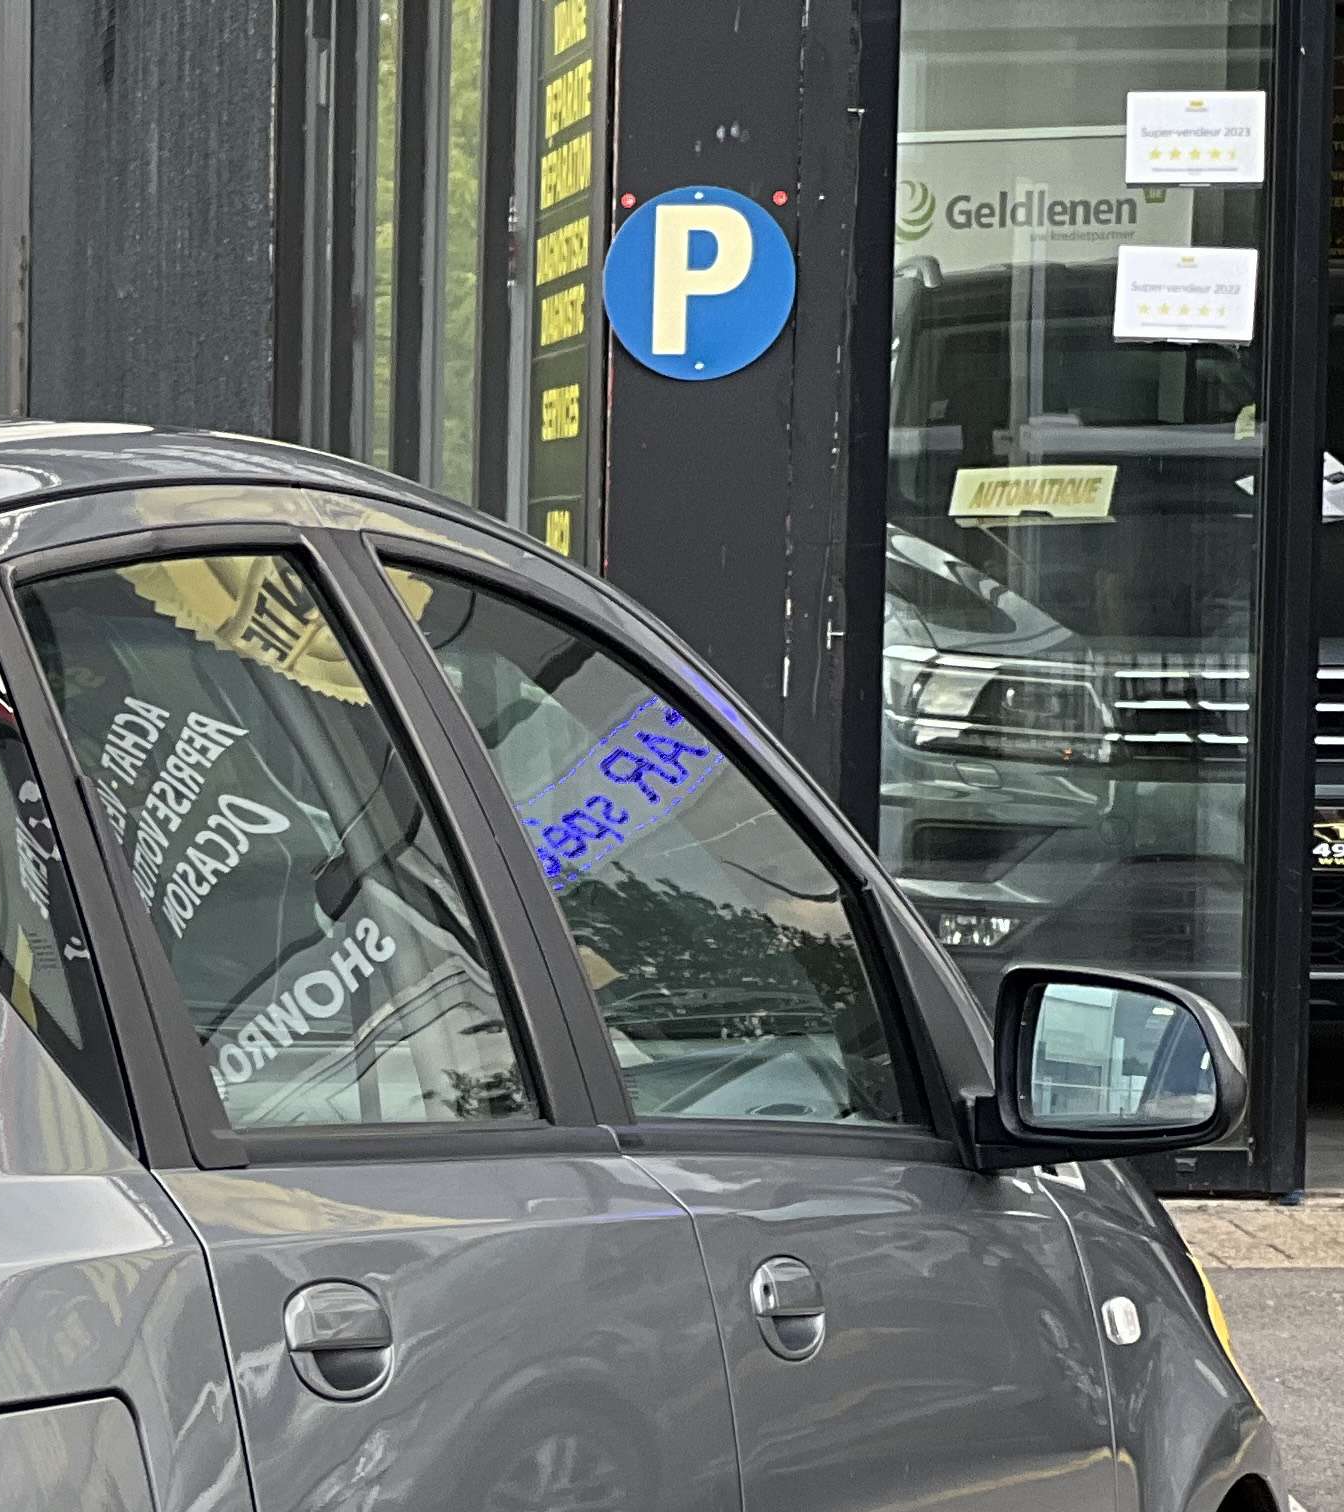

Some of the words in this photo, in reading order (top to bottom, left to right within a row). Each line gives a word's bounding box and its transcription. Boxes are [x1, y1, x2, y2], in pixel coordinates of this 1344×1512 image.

[1140, 127, 1222, 138] Super-vendeur
[1224, 127, 1251, 137] 2023
[945, 190, 1137, 229] Geldlenen
[652, 205, 753, 356] P
[969, 477, 1103, 509] AUTOMATIQUE
